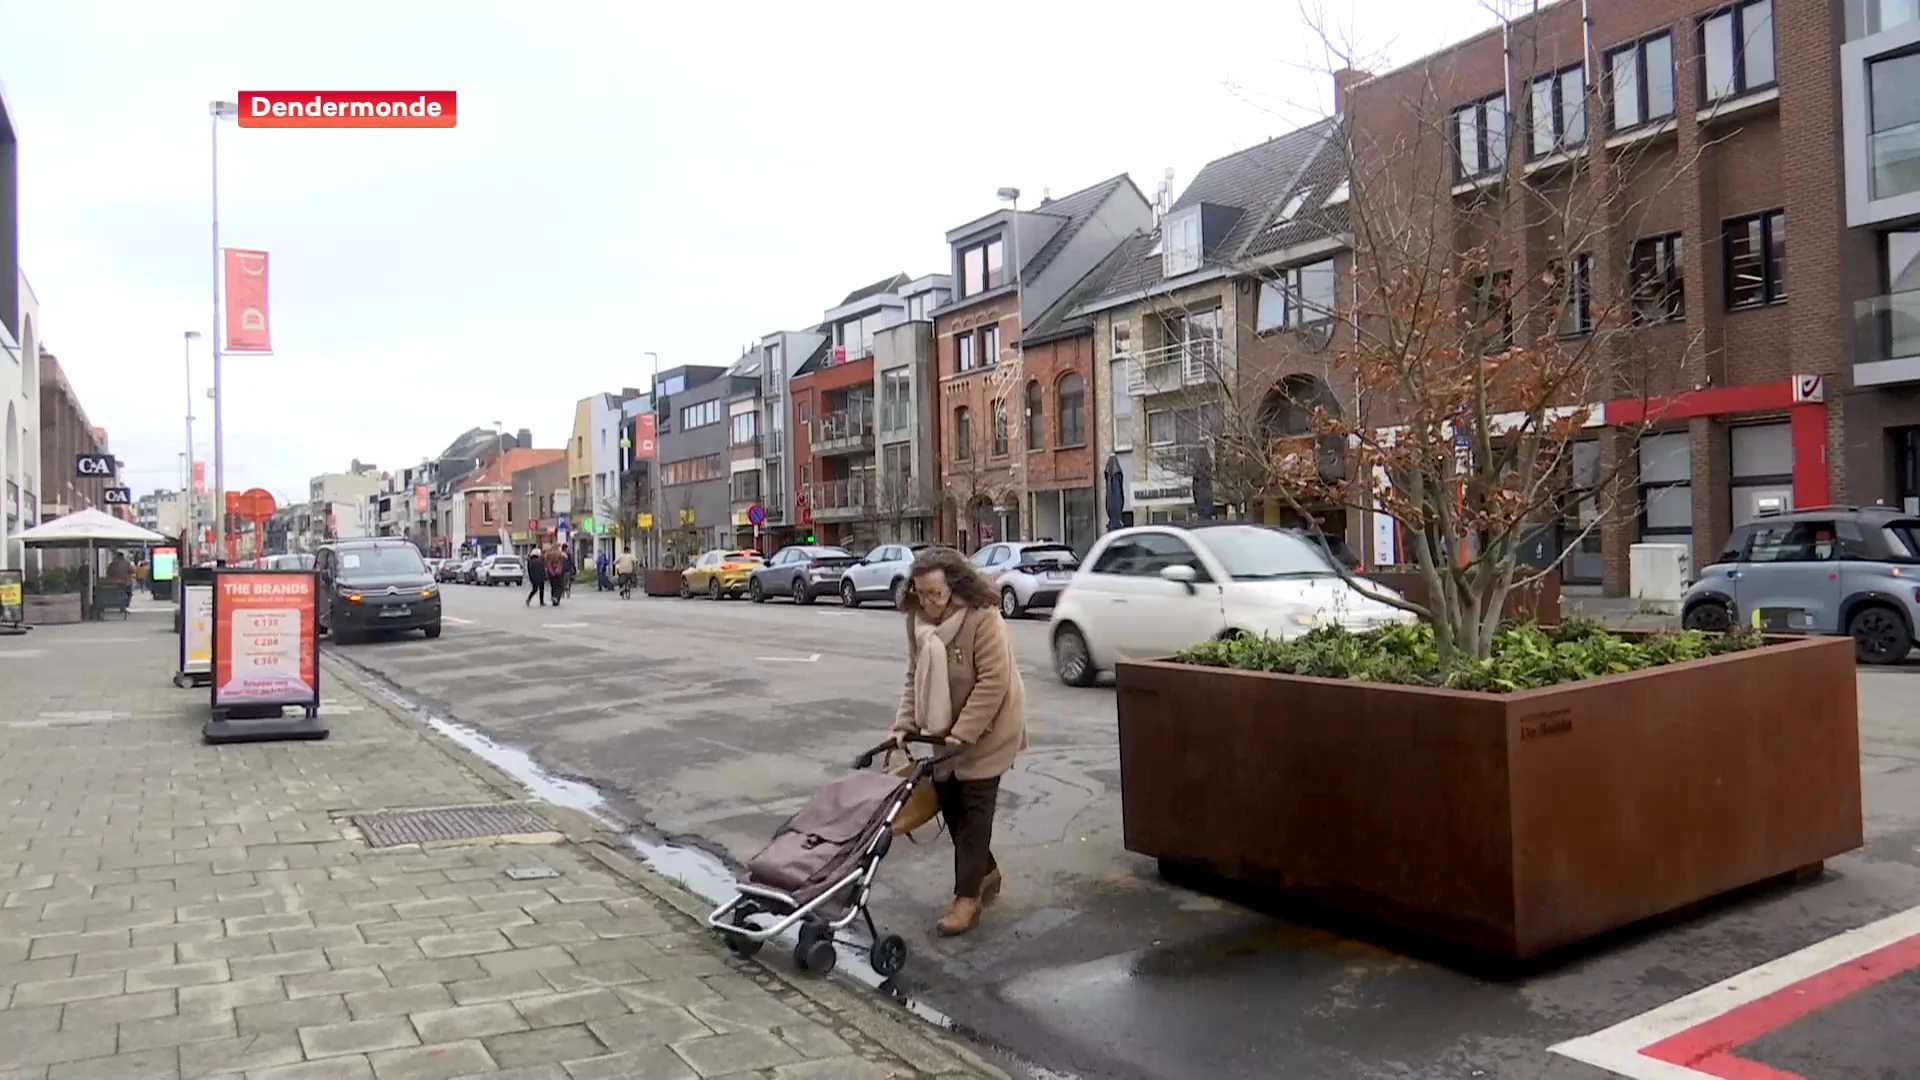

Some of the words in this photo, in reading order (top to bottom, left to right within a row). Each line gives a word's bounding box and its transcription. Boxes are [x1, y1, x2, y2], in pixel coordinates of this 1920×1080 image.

[78, 457, 110, 474] C&A
[104, 490, 128, 502] C&A
[224, 584, 251, 595] THE
[253, 583, 309, 595] BRANDS
